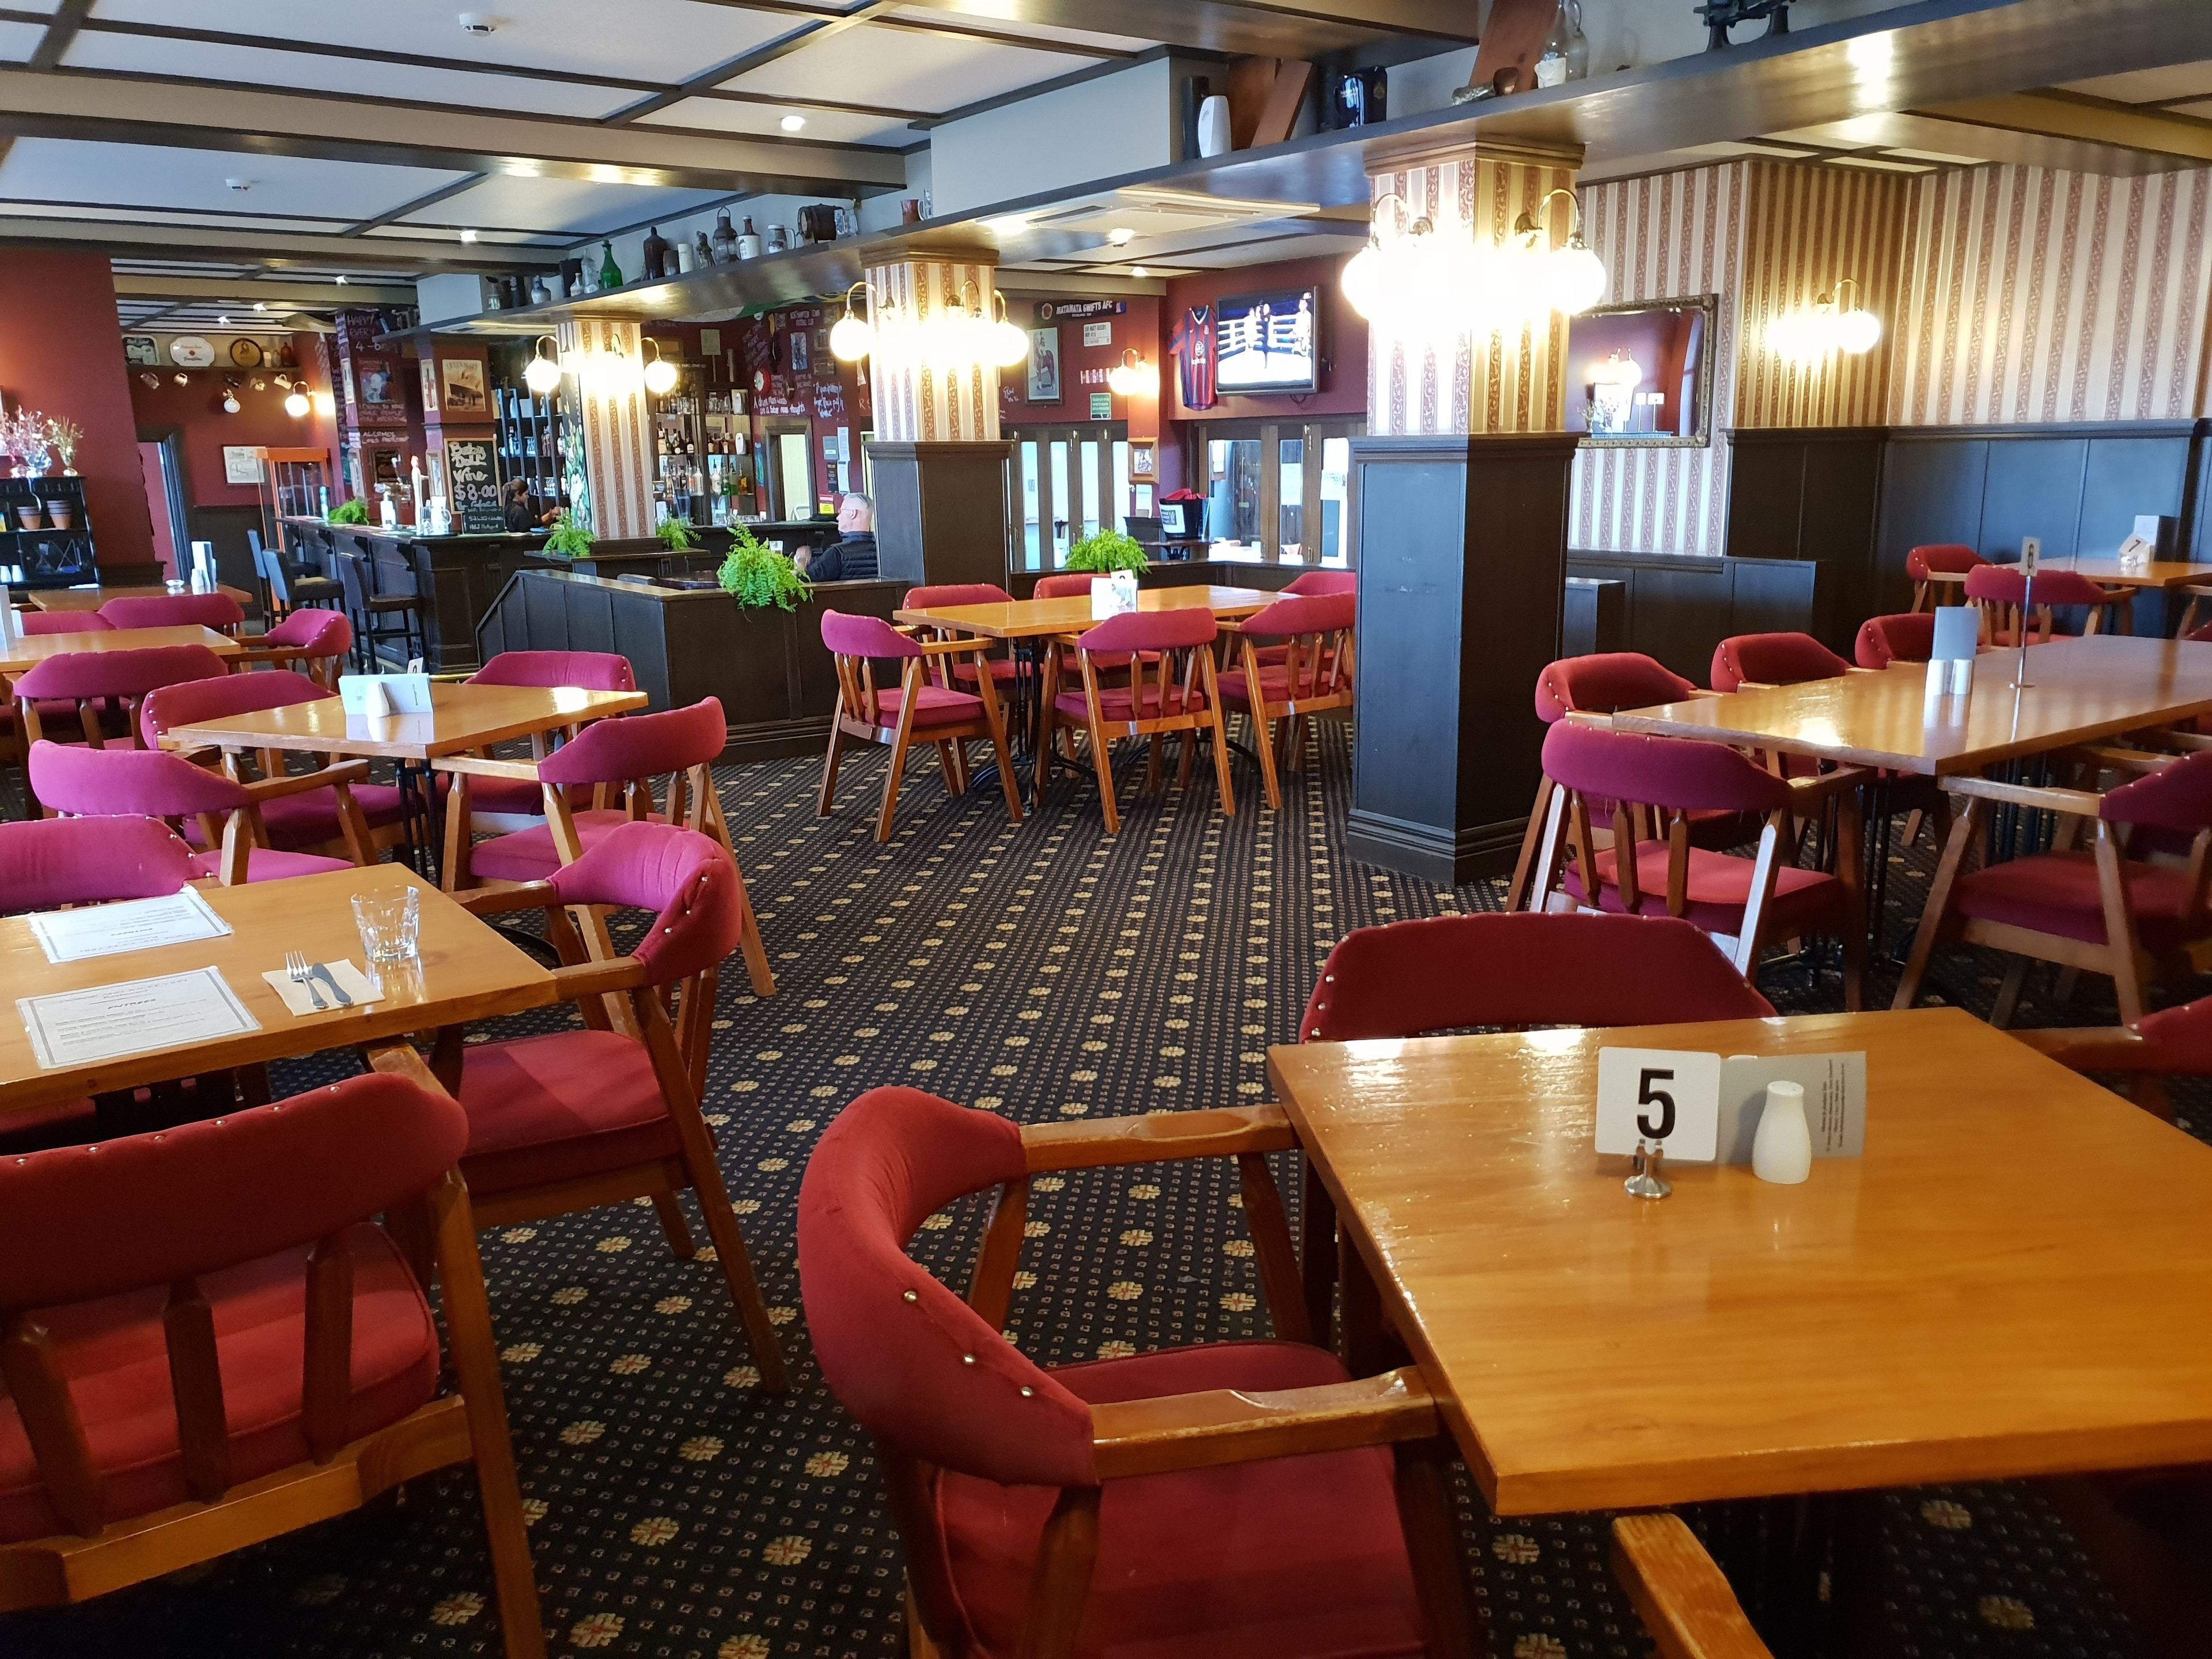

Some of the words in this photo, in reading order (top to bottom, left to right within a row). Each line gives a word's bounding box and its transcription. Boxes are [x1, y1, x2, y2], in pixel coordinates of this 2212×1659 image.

[1056, 304, 1082, 315] MATAMATA
[1083, 301, 1101, 312] SWIFTS
[1103, 300, 1113, 309] AFC
[347, 313, 374, 325] HAPPY
[448, 441, 487, 460] Baby
[2128, 539, 2141, 552] 7
[1637, 1068, 1676, 1139] 5
